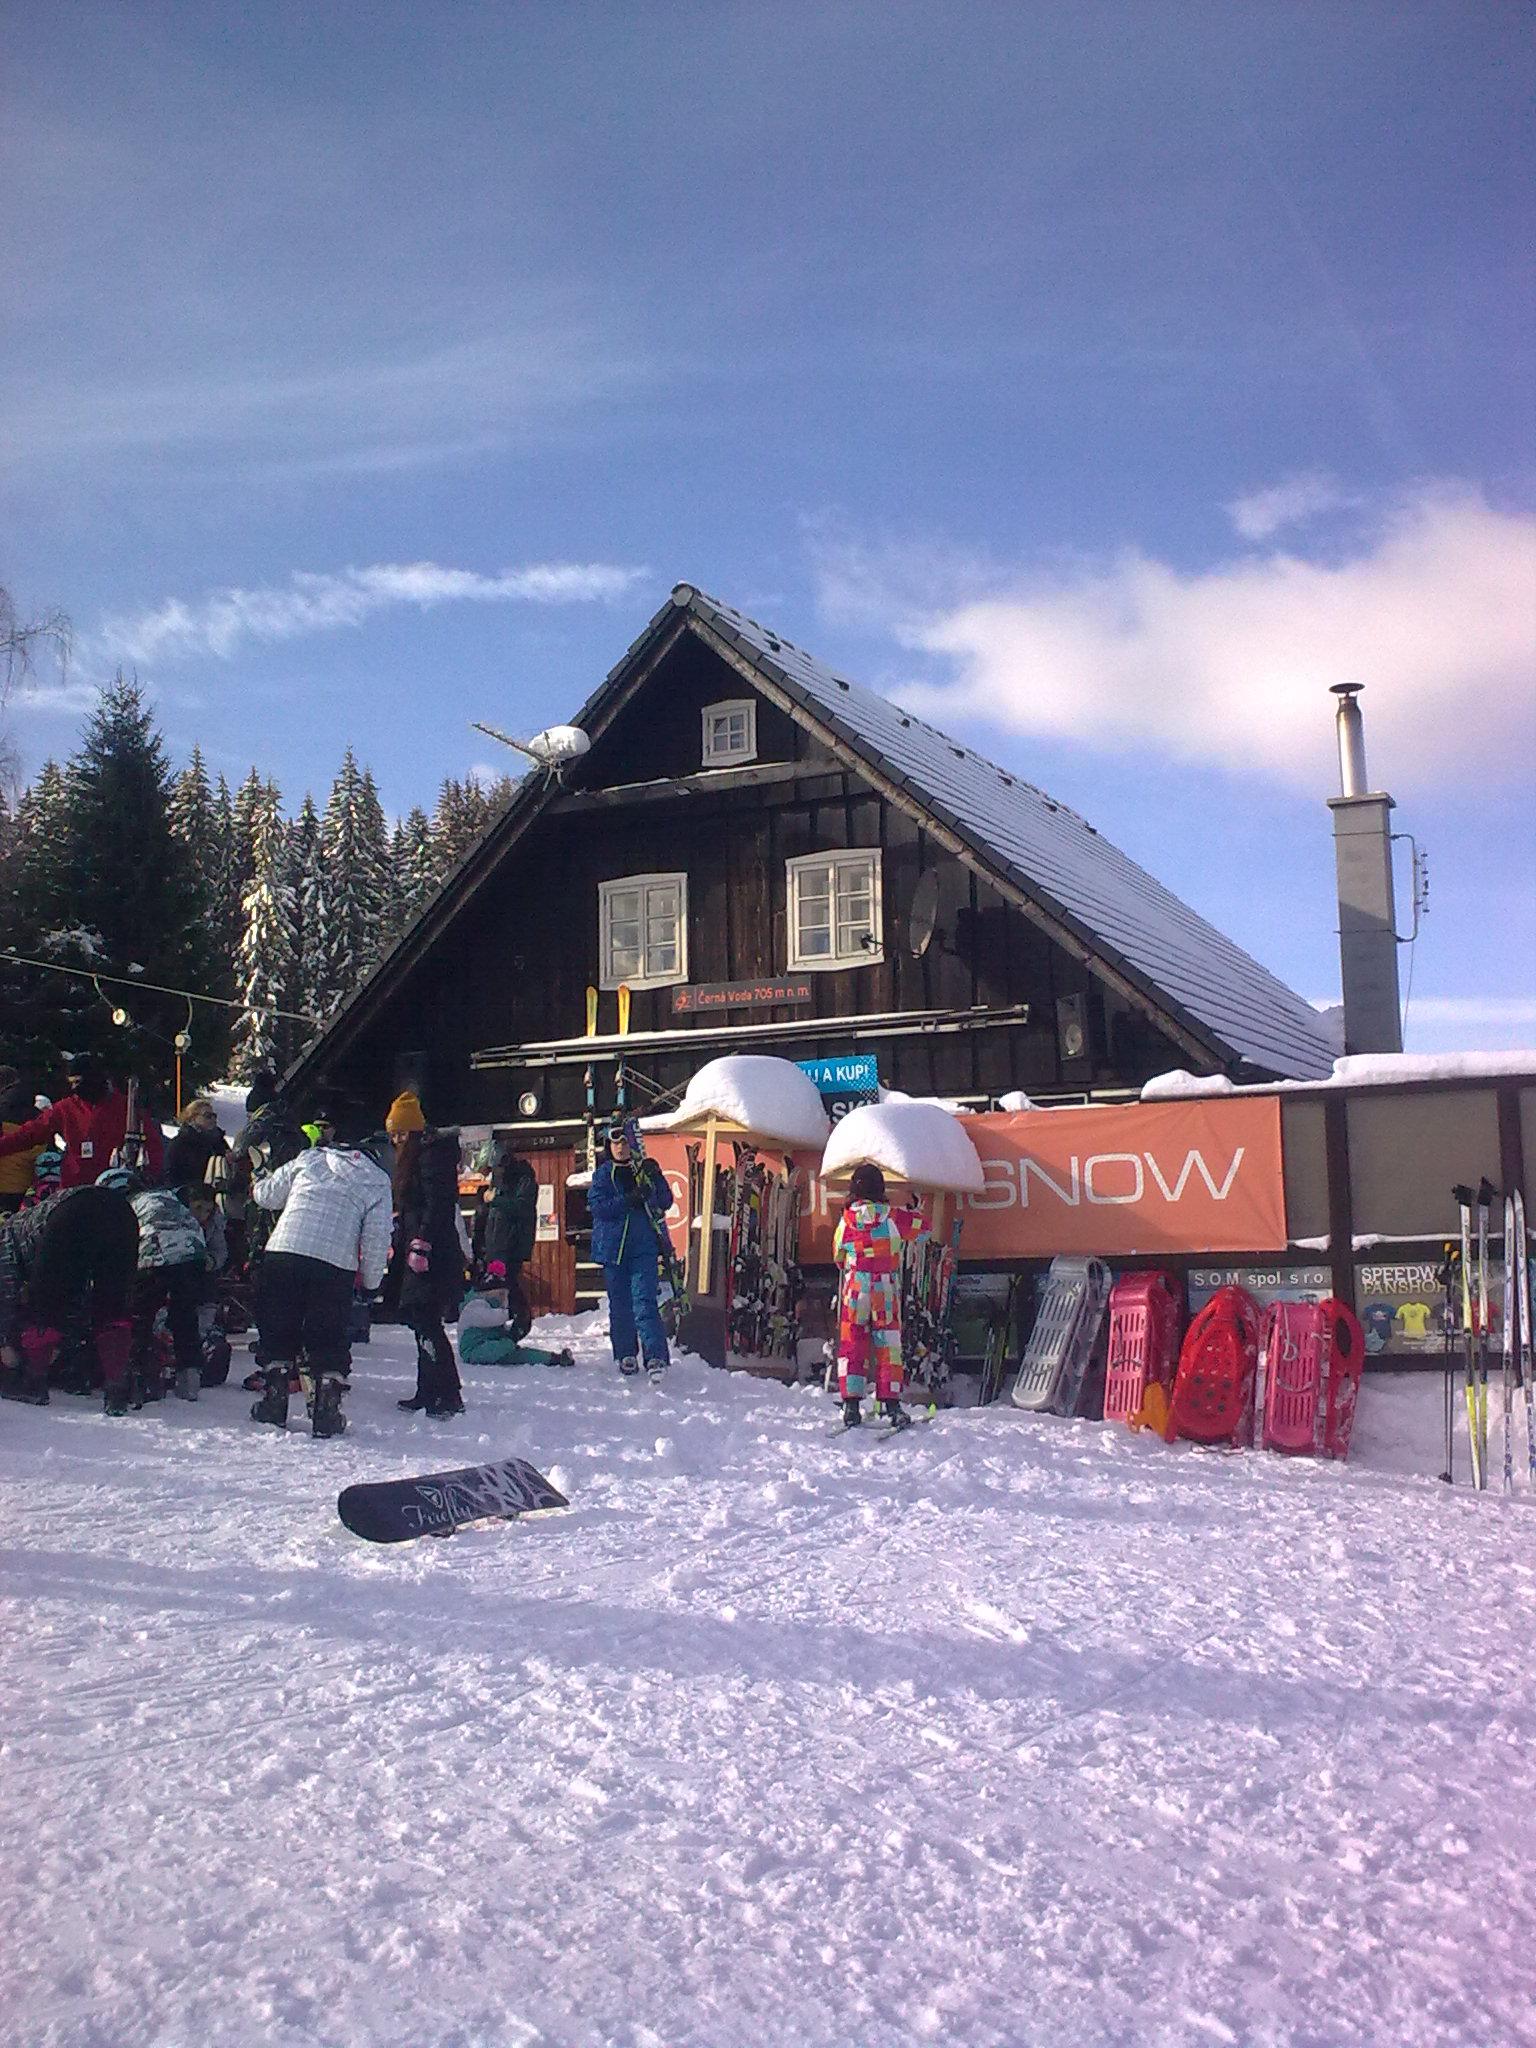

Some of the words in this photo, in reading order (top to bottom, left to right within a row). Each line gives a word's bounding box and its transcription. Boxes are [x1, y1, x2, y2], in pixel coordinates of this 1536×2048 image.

[754, 986, 773, 1000] 705
[775, 988, 785, 998] m
[823, 1067, 833, 1082] A
[1289, 1273, 1299, 1285] s
[1361, 1264, 1445, 1284] SPEEDW
